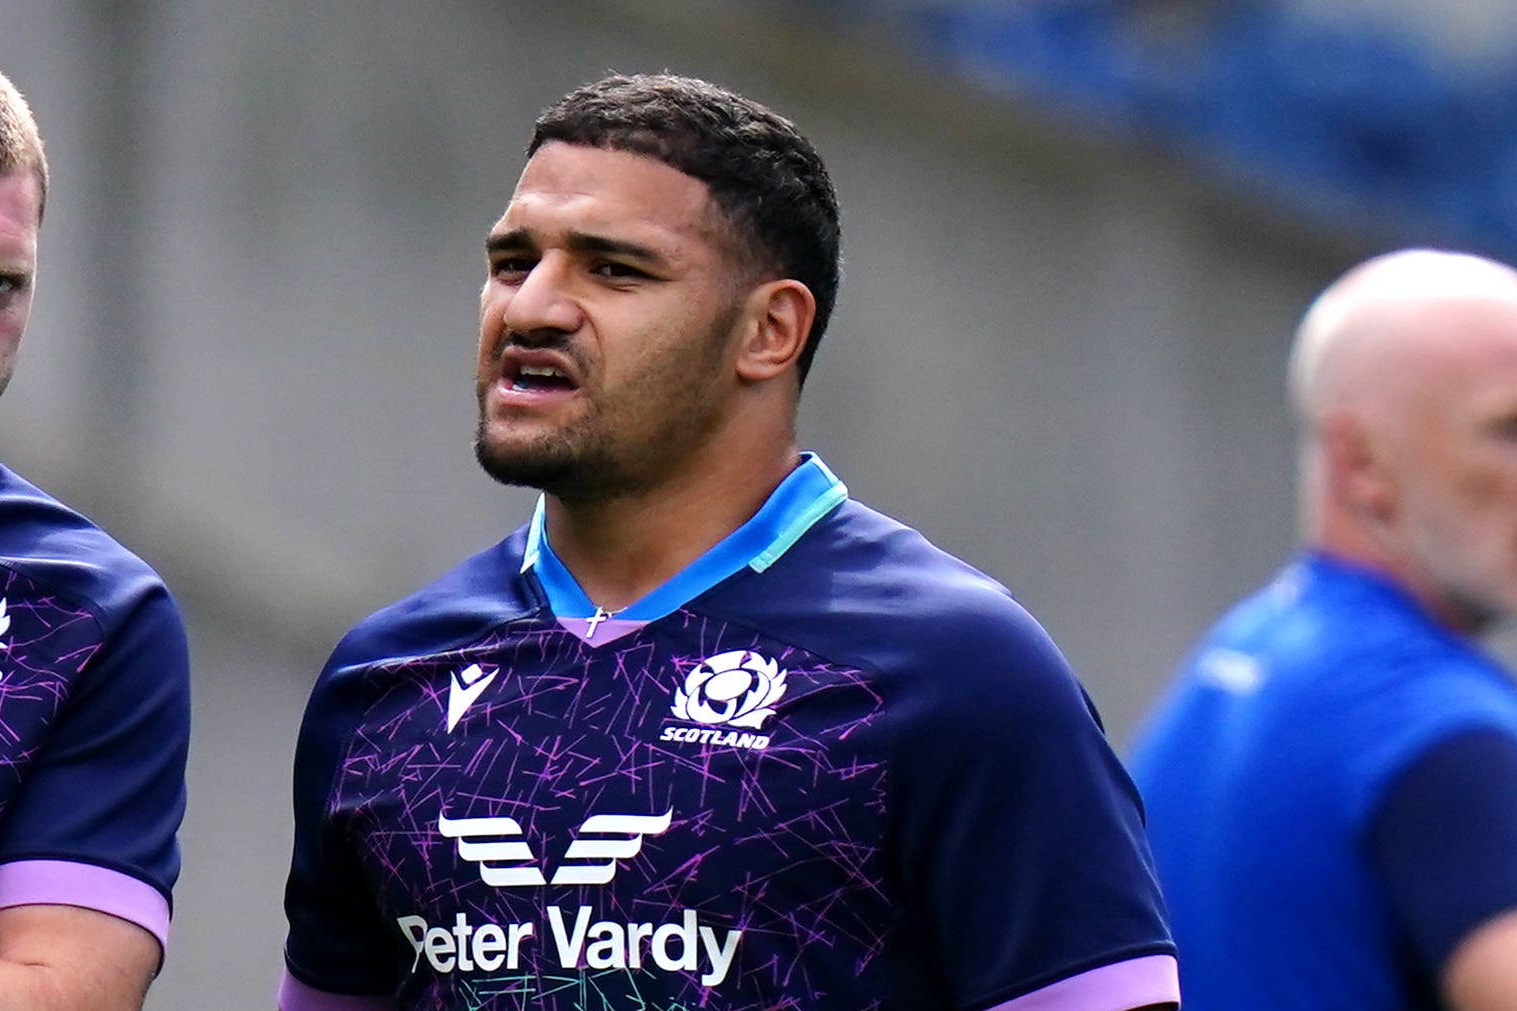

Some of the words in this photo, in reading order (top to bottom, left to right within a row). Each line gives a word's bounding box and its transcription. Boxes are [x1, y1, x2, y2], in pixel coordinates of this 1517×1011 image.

[659, 726, 771, 750] SCOTLAND
[396, 912, 534, 974] Peter
[546, 905, 743, 987] Vardy
